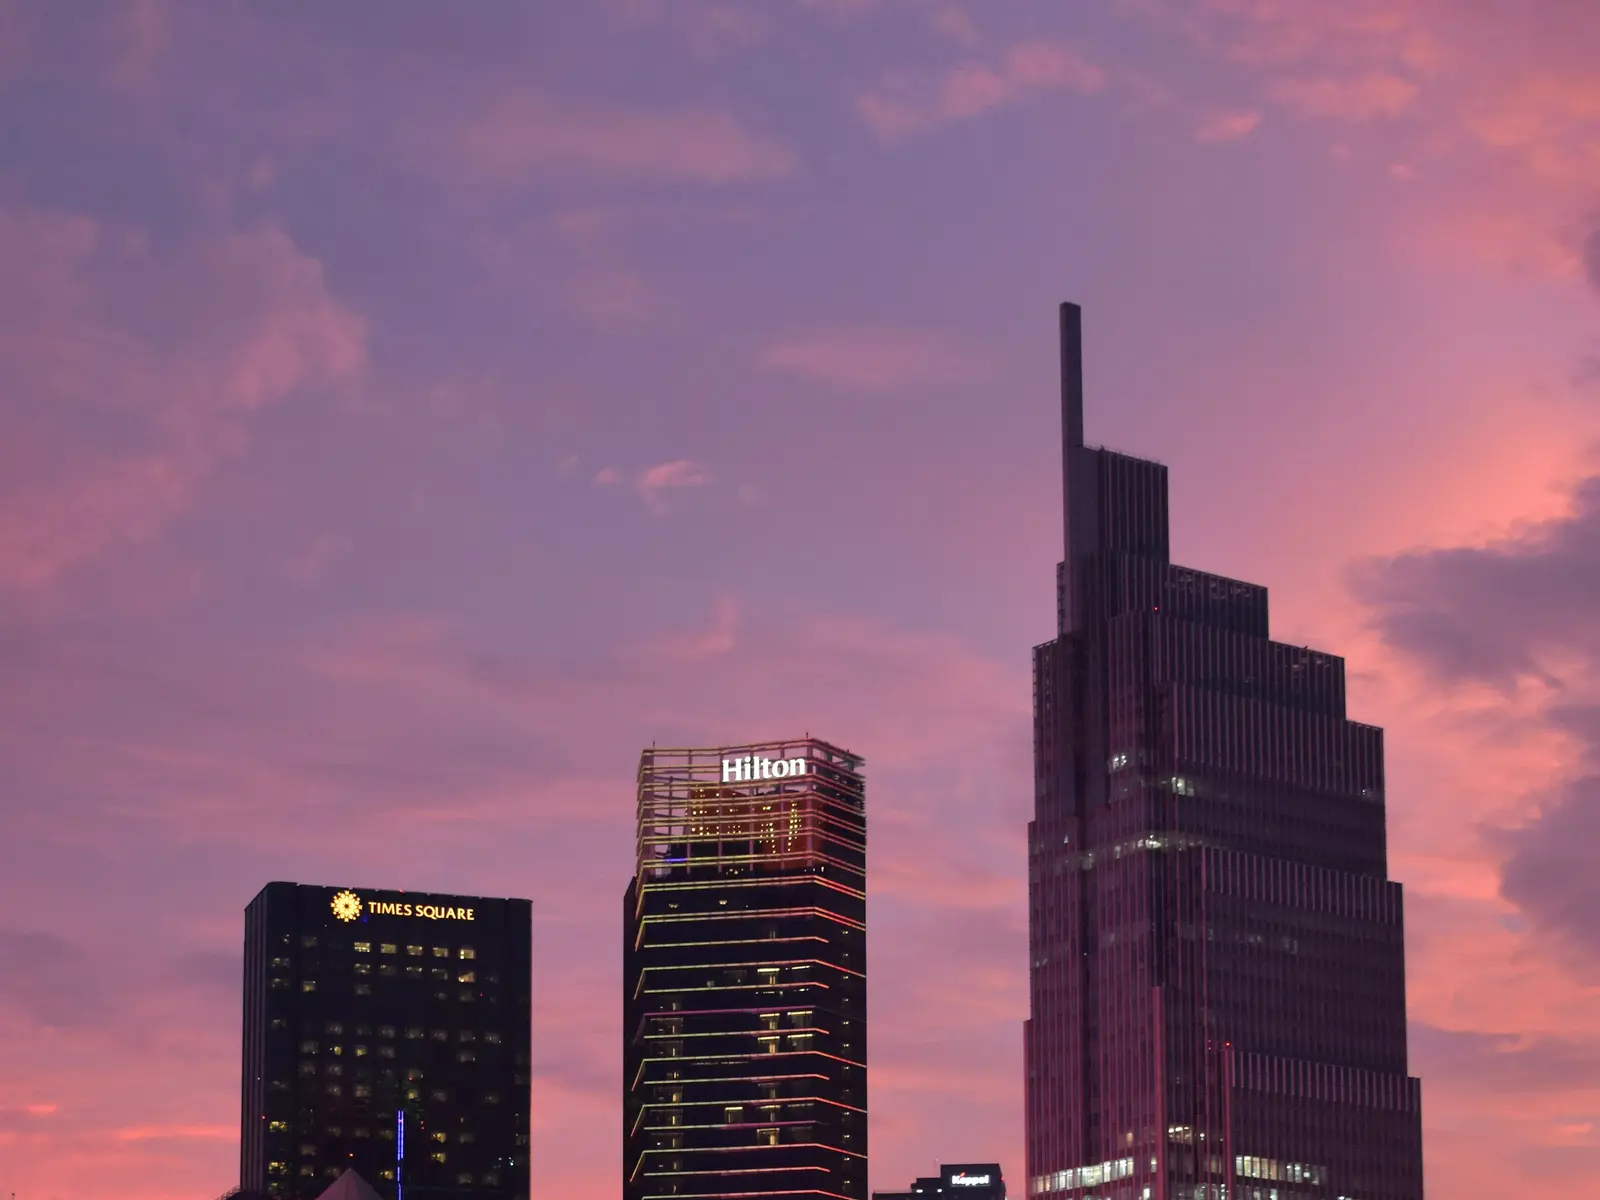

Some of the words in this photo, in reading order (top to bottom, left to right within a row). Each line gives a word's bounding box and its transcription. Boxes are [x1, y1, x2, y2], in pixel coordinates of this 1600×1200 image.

[722, 756, 806, 782] Hilton
[368, 901, 412, 916] TIMES
[415, 905, 475, 921] SQUARE
